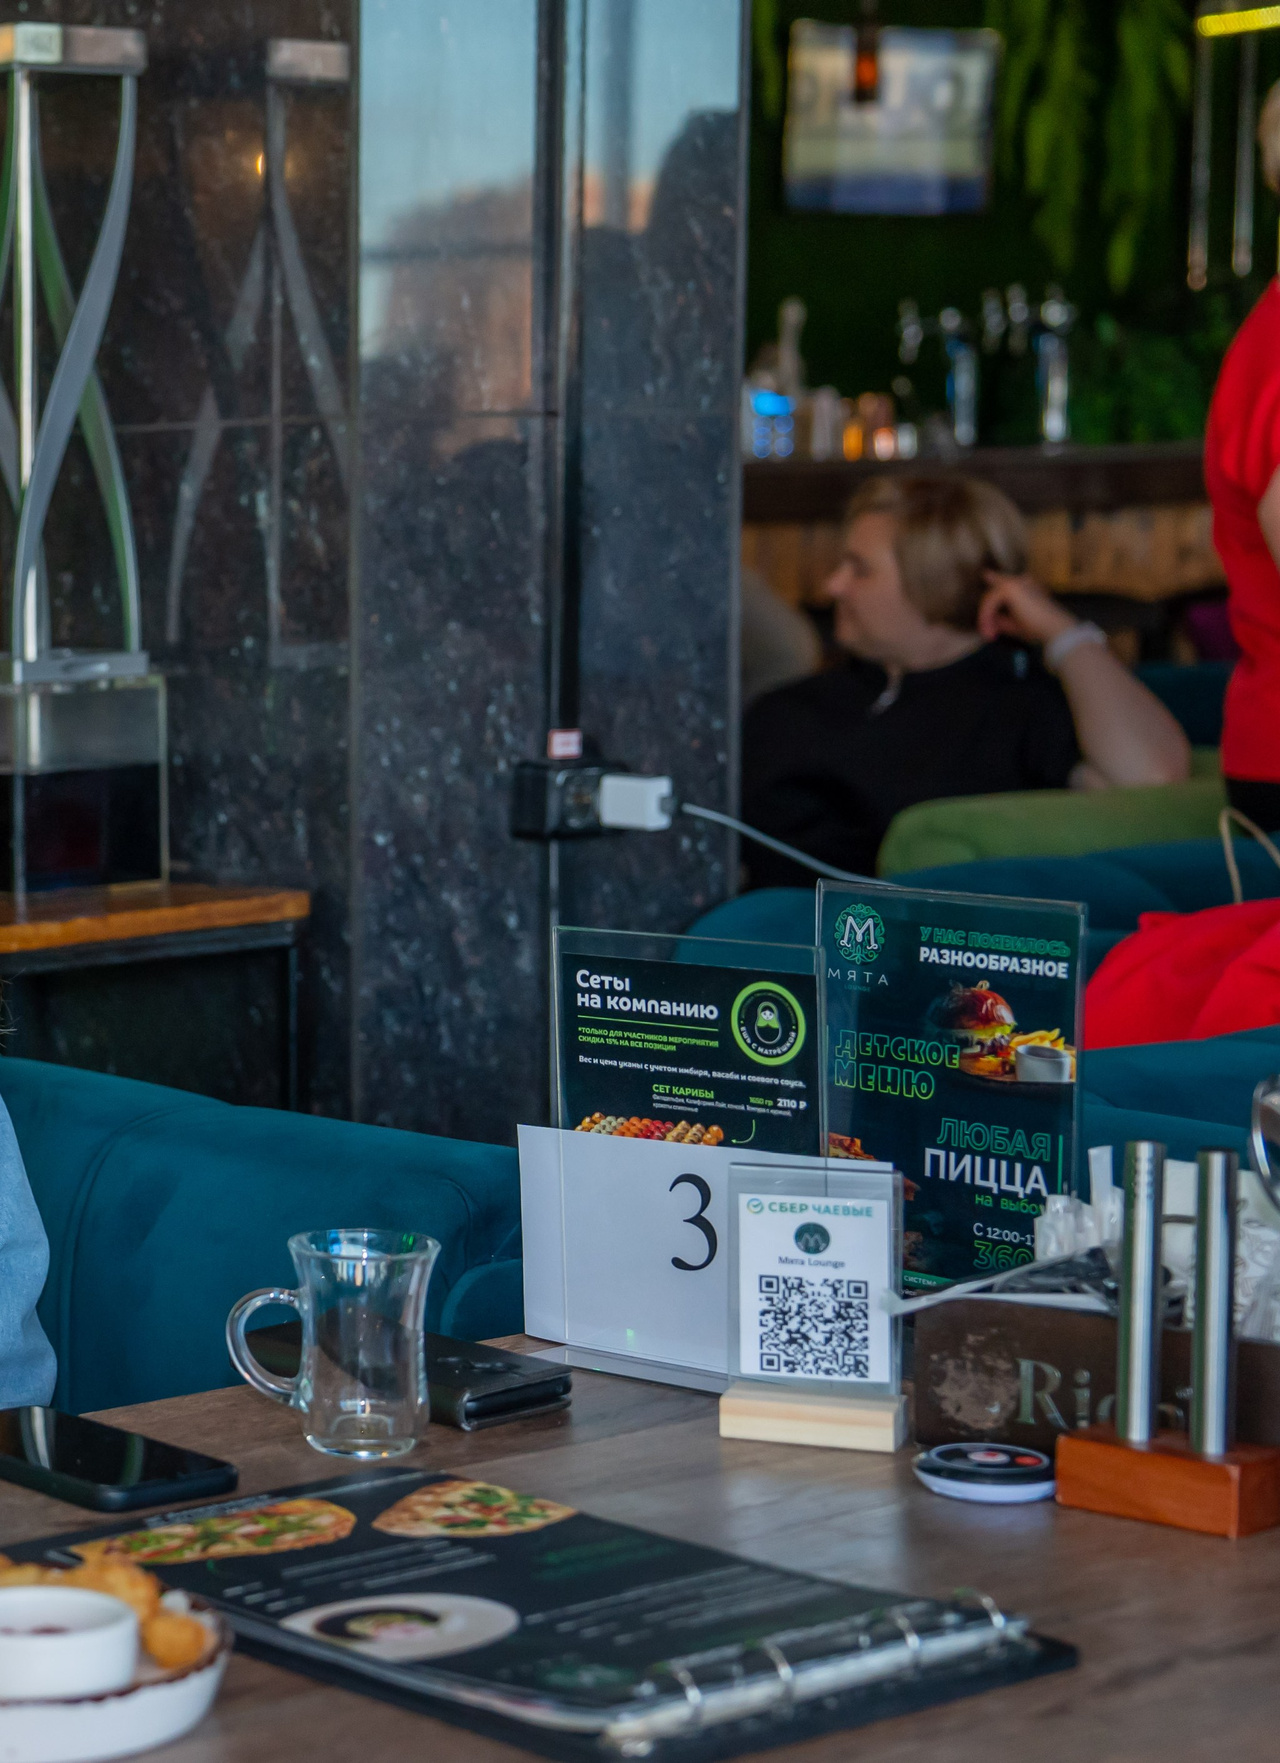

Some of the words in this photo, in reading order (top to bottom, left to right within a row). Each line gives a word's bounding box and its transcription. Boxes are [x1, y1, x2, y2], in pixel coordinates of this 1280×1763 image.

[920, 926, 932, 941] У
[933, 928, 966, 946] НАС
[968, 931, 1070, 957] ПОЯВИЛОСЬ
[919, 946, 1069, 979] РАЗНООБРАЗНОЕ
[576, 969, 631, 992] Сеты
[827, 967, 889, 986] МЯТА
[577, 993, 601, 1009] на
[606, 995, 719, 1020] компанию
[578, 1035, 605, 1045] СКИДКА
[606, 1038, 619, 1046] 15%
[643, 1042, 677, 1052] ПОЗИЦИИ
[608, 1030, 622, 1038] ДЛЯ
[623, 1031, 668, 1043] УЧАСТНИКОВ
[835, 1029, 960, 1068] ДЕТСКОЕ
[579, 1055, 592, 1064] Вес
[599, 1058, 618, 1067] цена
[835, 1059, 935, 1099] МЕНЮ
[652, 1084, 671, 1094] СЕТ
[672, 1085, 715, 1099] КАРИБЫ
[937, 1117, 1051, 1162] ЛЮБАЯ
[924, 1147, 1049, 1199] ПИЦЦА
[768, 1202, 808, 1214] СБЕР
[812, 1203, 873, 1218] ЧАЕВЫЕ
[975, 1193, 993, 1207] на
[1001, 1198, 1046, 1215] выбо
[669, 1173, 718, 1271] 3
[807, 1258, 846, 1269] Lounge
